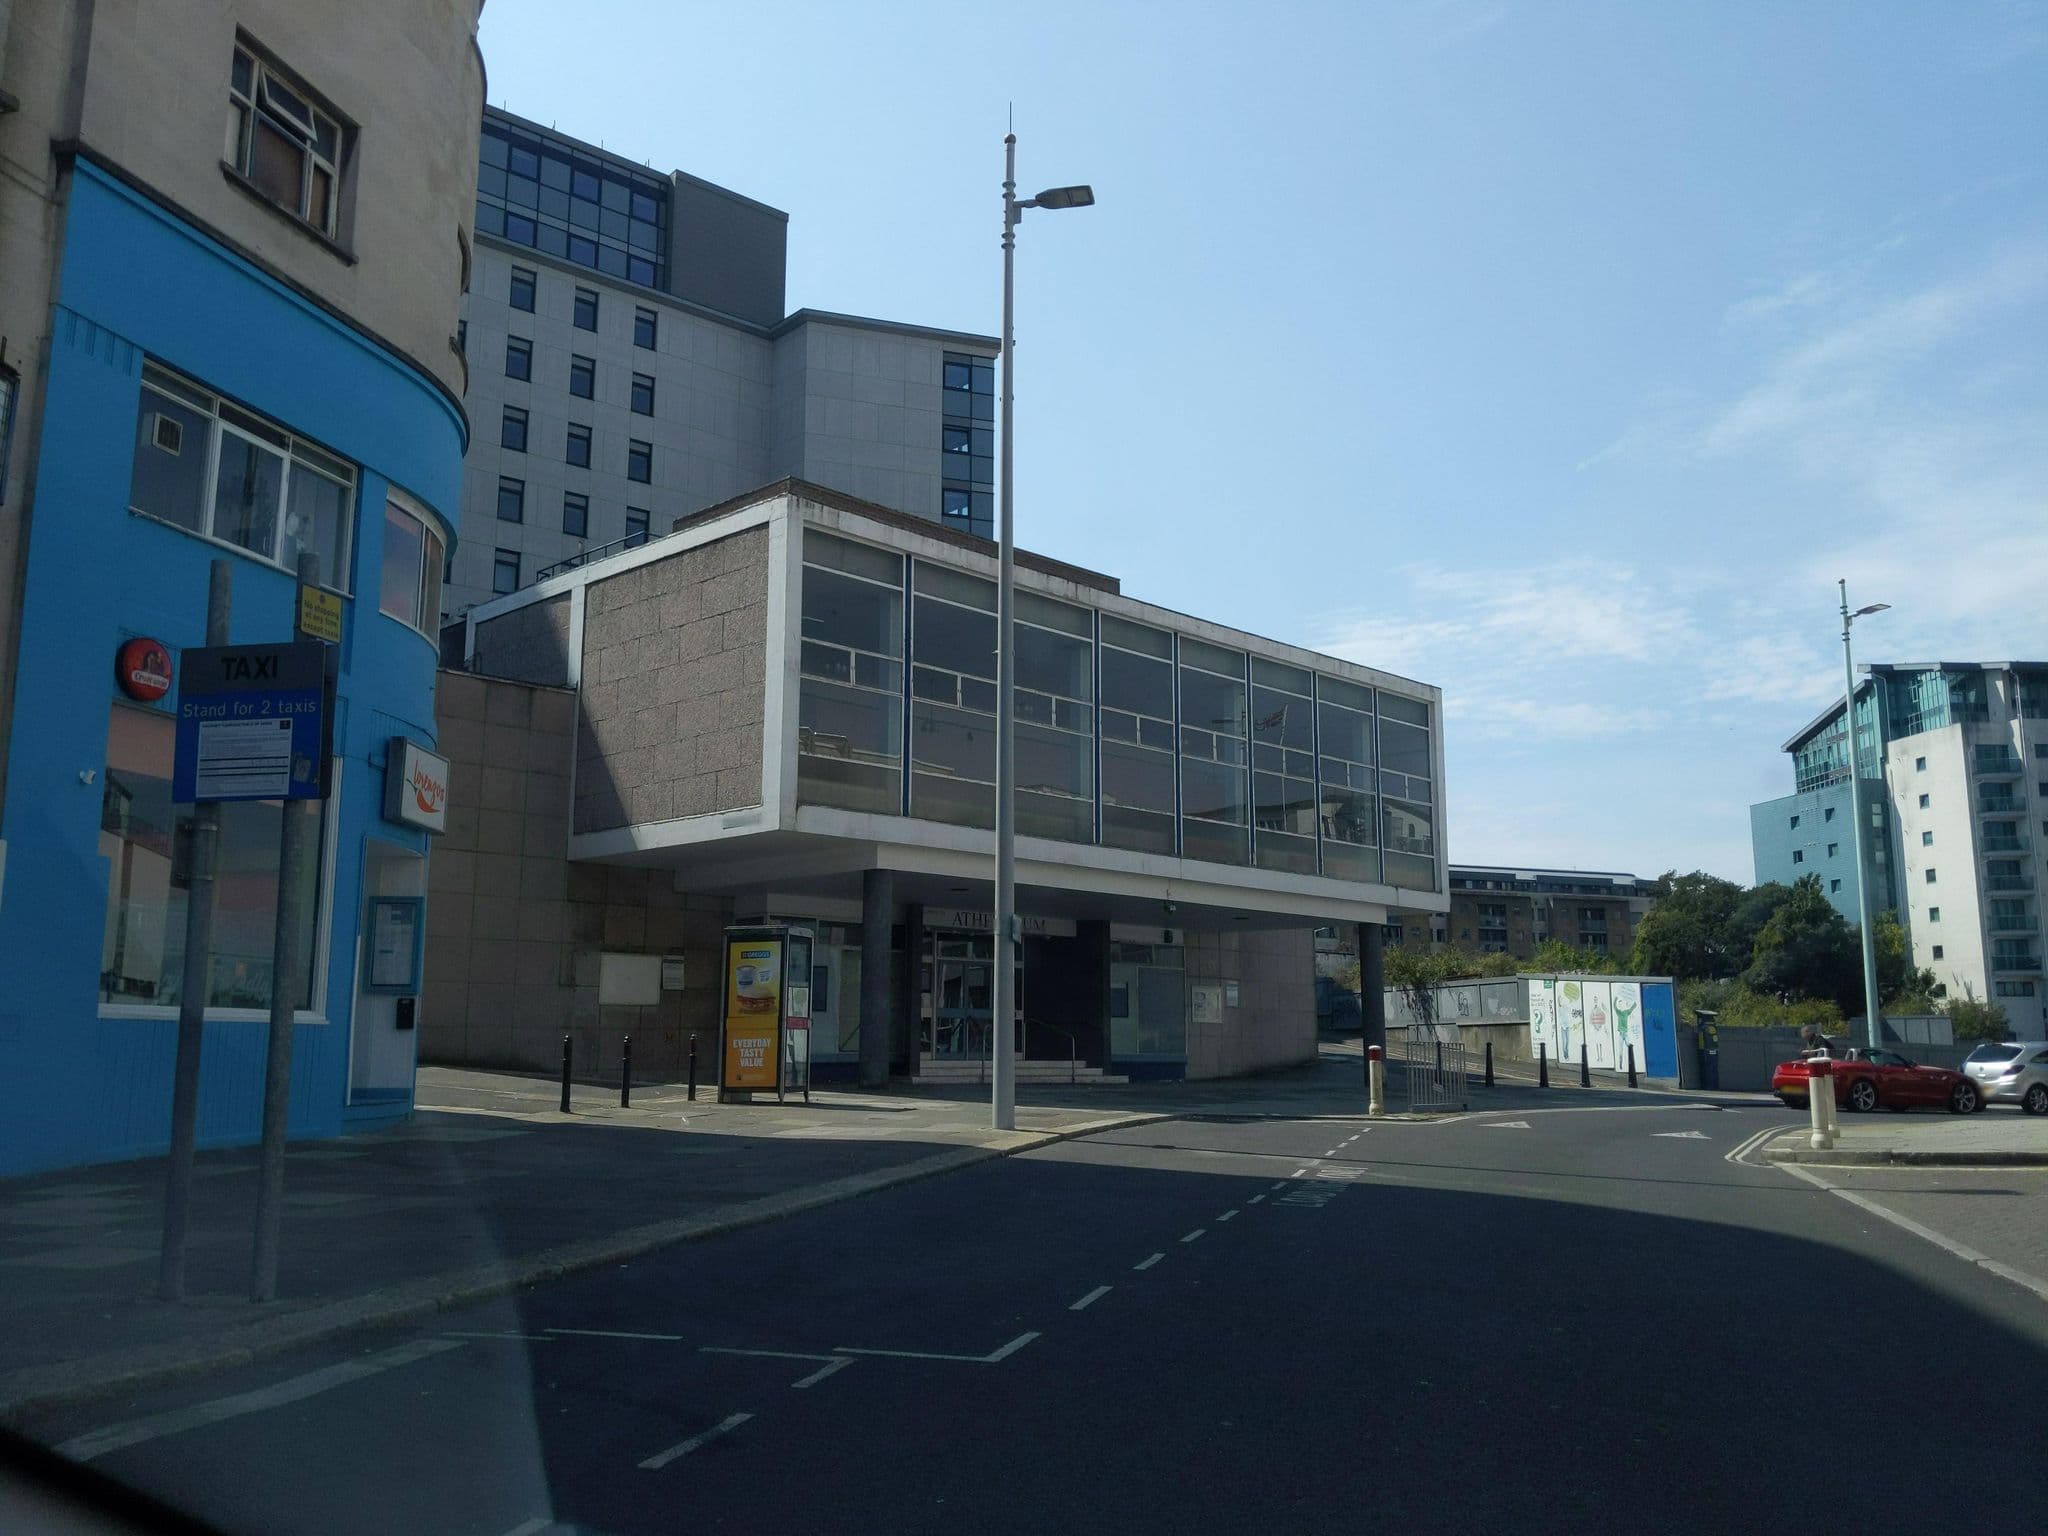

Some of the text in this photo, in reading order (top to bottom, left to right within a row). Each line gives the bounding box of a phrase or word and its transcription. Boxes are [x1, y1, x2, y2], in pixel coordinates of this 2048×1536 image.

[221, 655, 278, 681] TAXI
[183, 699, 317, 718] Stand for 2 taxis
[733, 1039, 771, 1048] EVERYDAY
[740, 1048, 764, 1057] TASTY
[740, 1058, 764, 1067] VALUE
